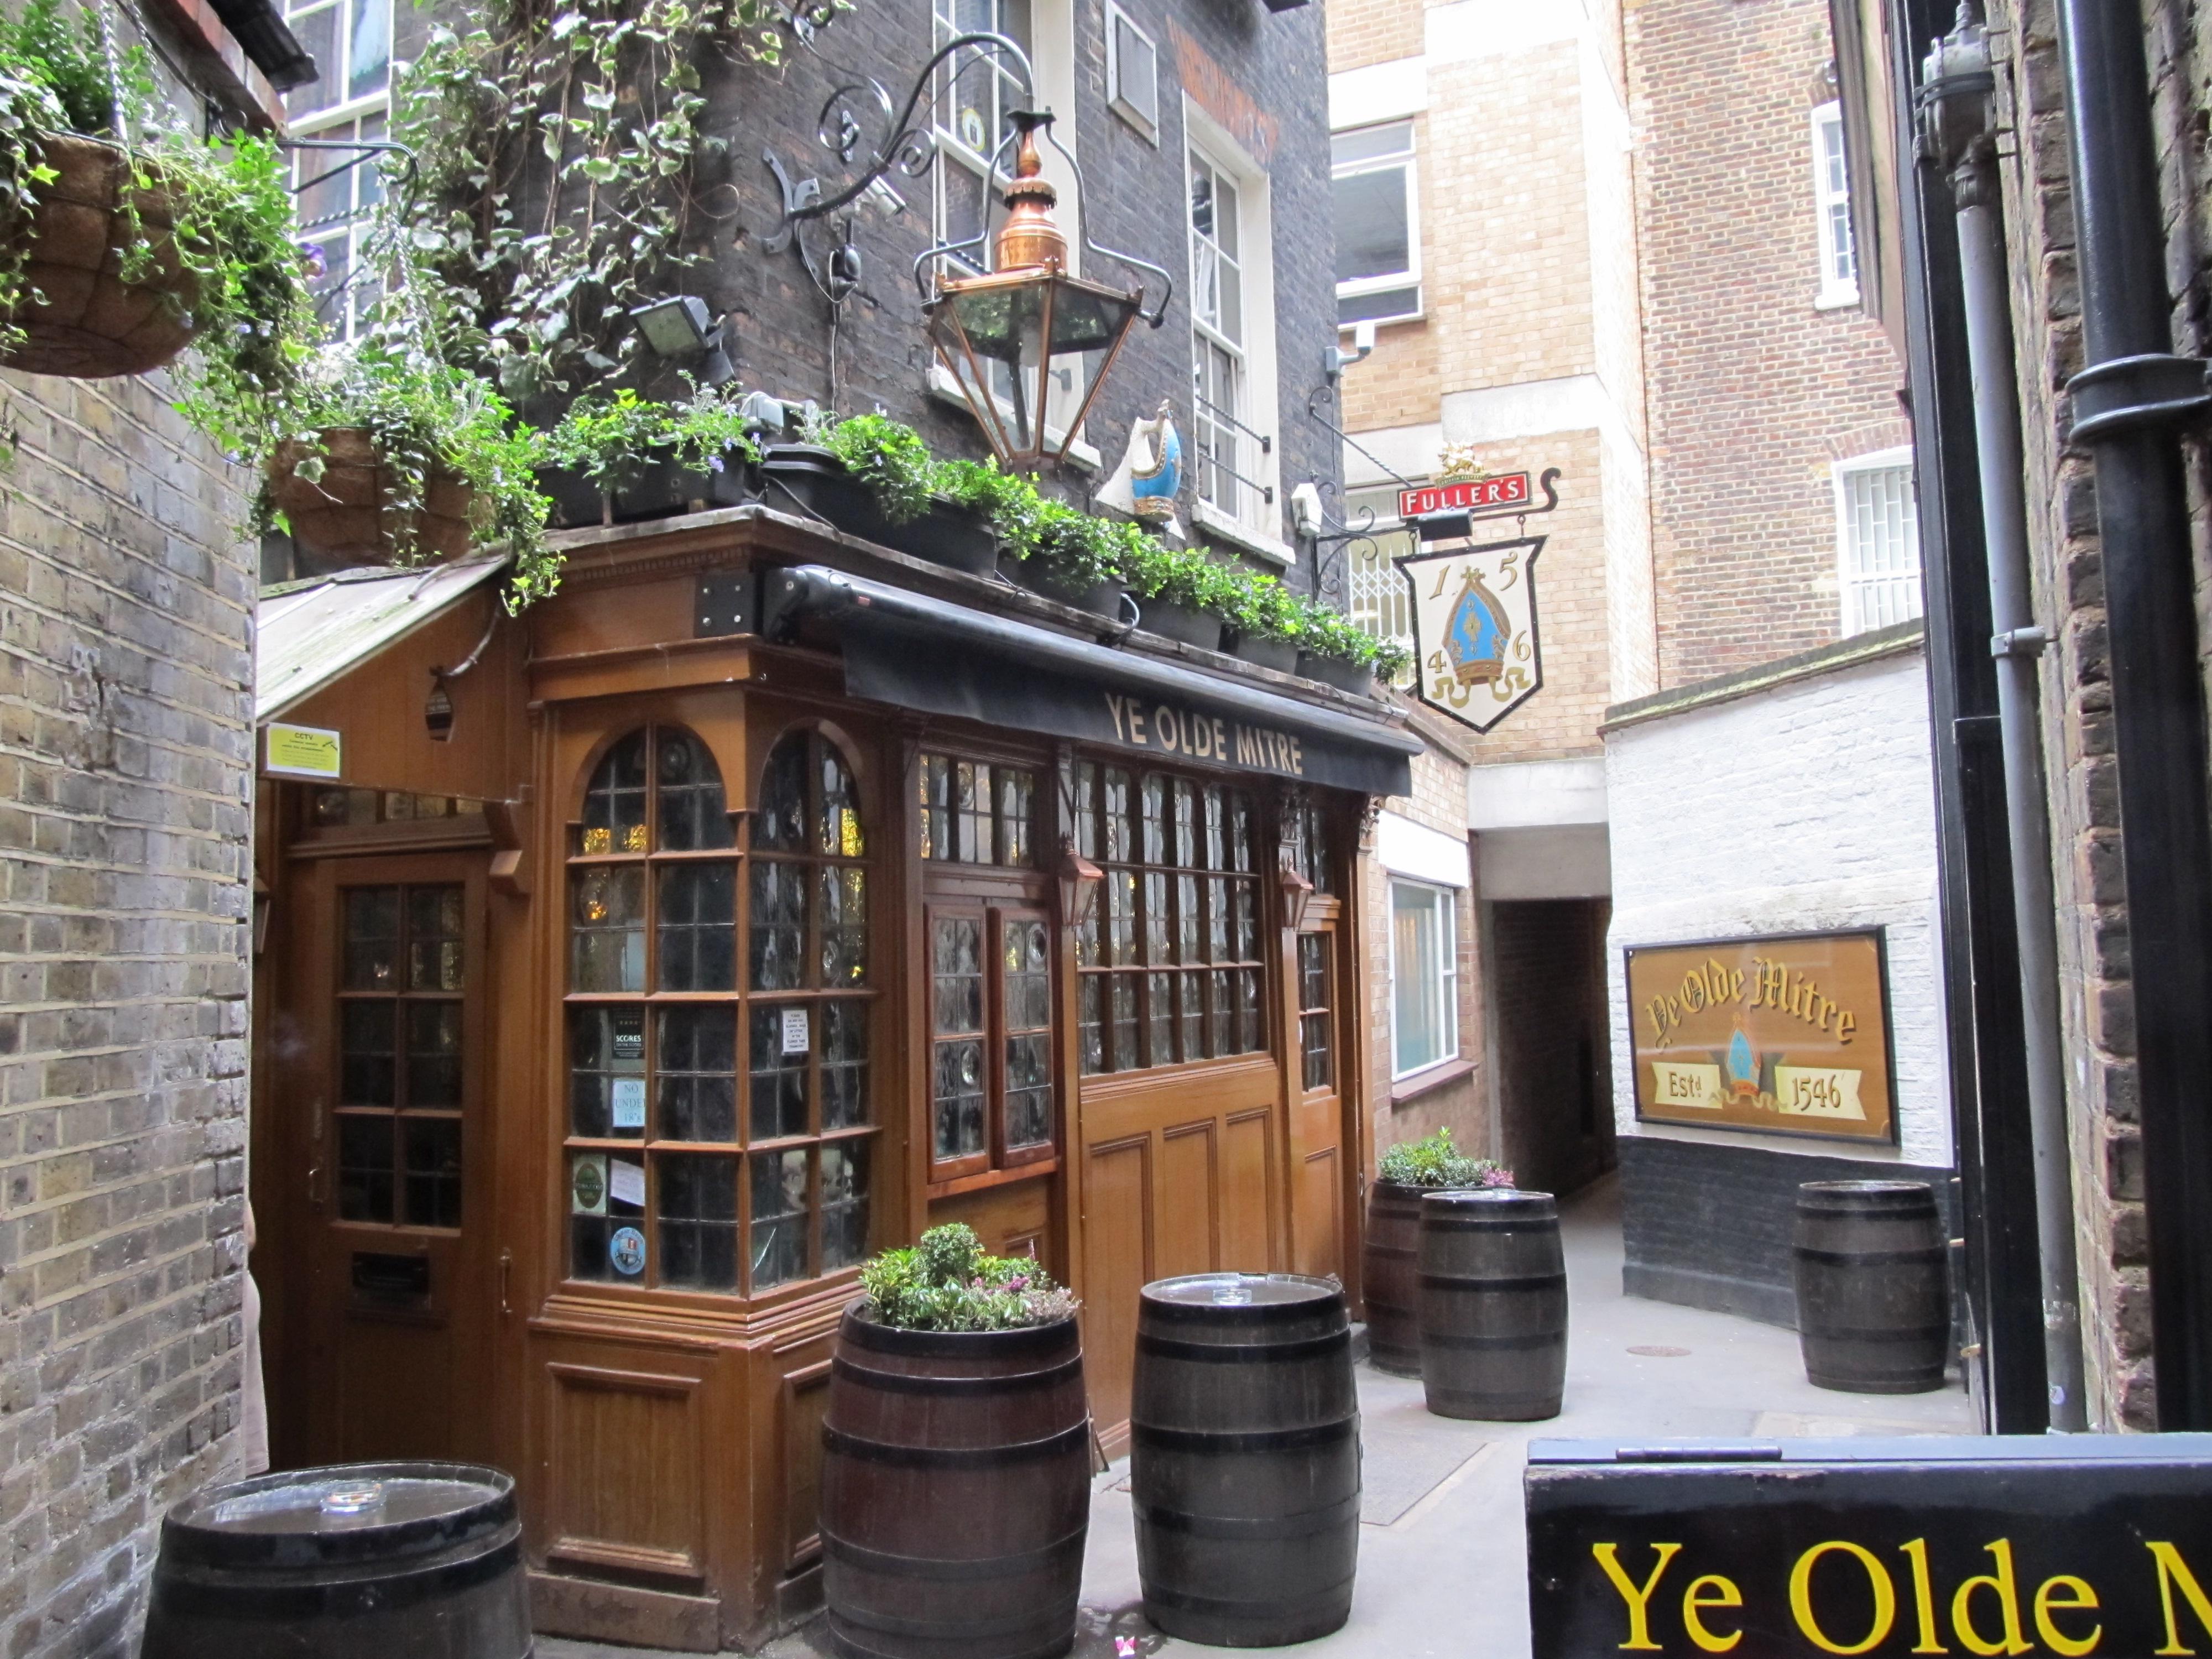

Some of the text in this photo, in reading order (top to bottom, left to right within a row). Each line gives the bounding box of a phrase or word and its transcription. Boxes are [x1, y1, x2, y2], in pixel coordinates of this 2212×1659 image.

[1406, 479, 1519, 513] FULLER'S
[1106, 693, 1303, 774] YE OLDE MITRE
[1646, 956, 1856, 1055] Ye Olde Mitre
[624, 1084, 638, 1093] NO
[1792, 1074, 1841, 1111] 1546
[1592, 1542, 1744, 1652] Ye
[1788, 1537, 2102, 1657] Olde
